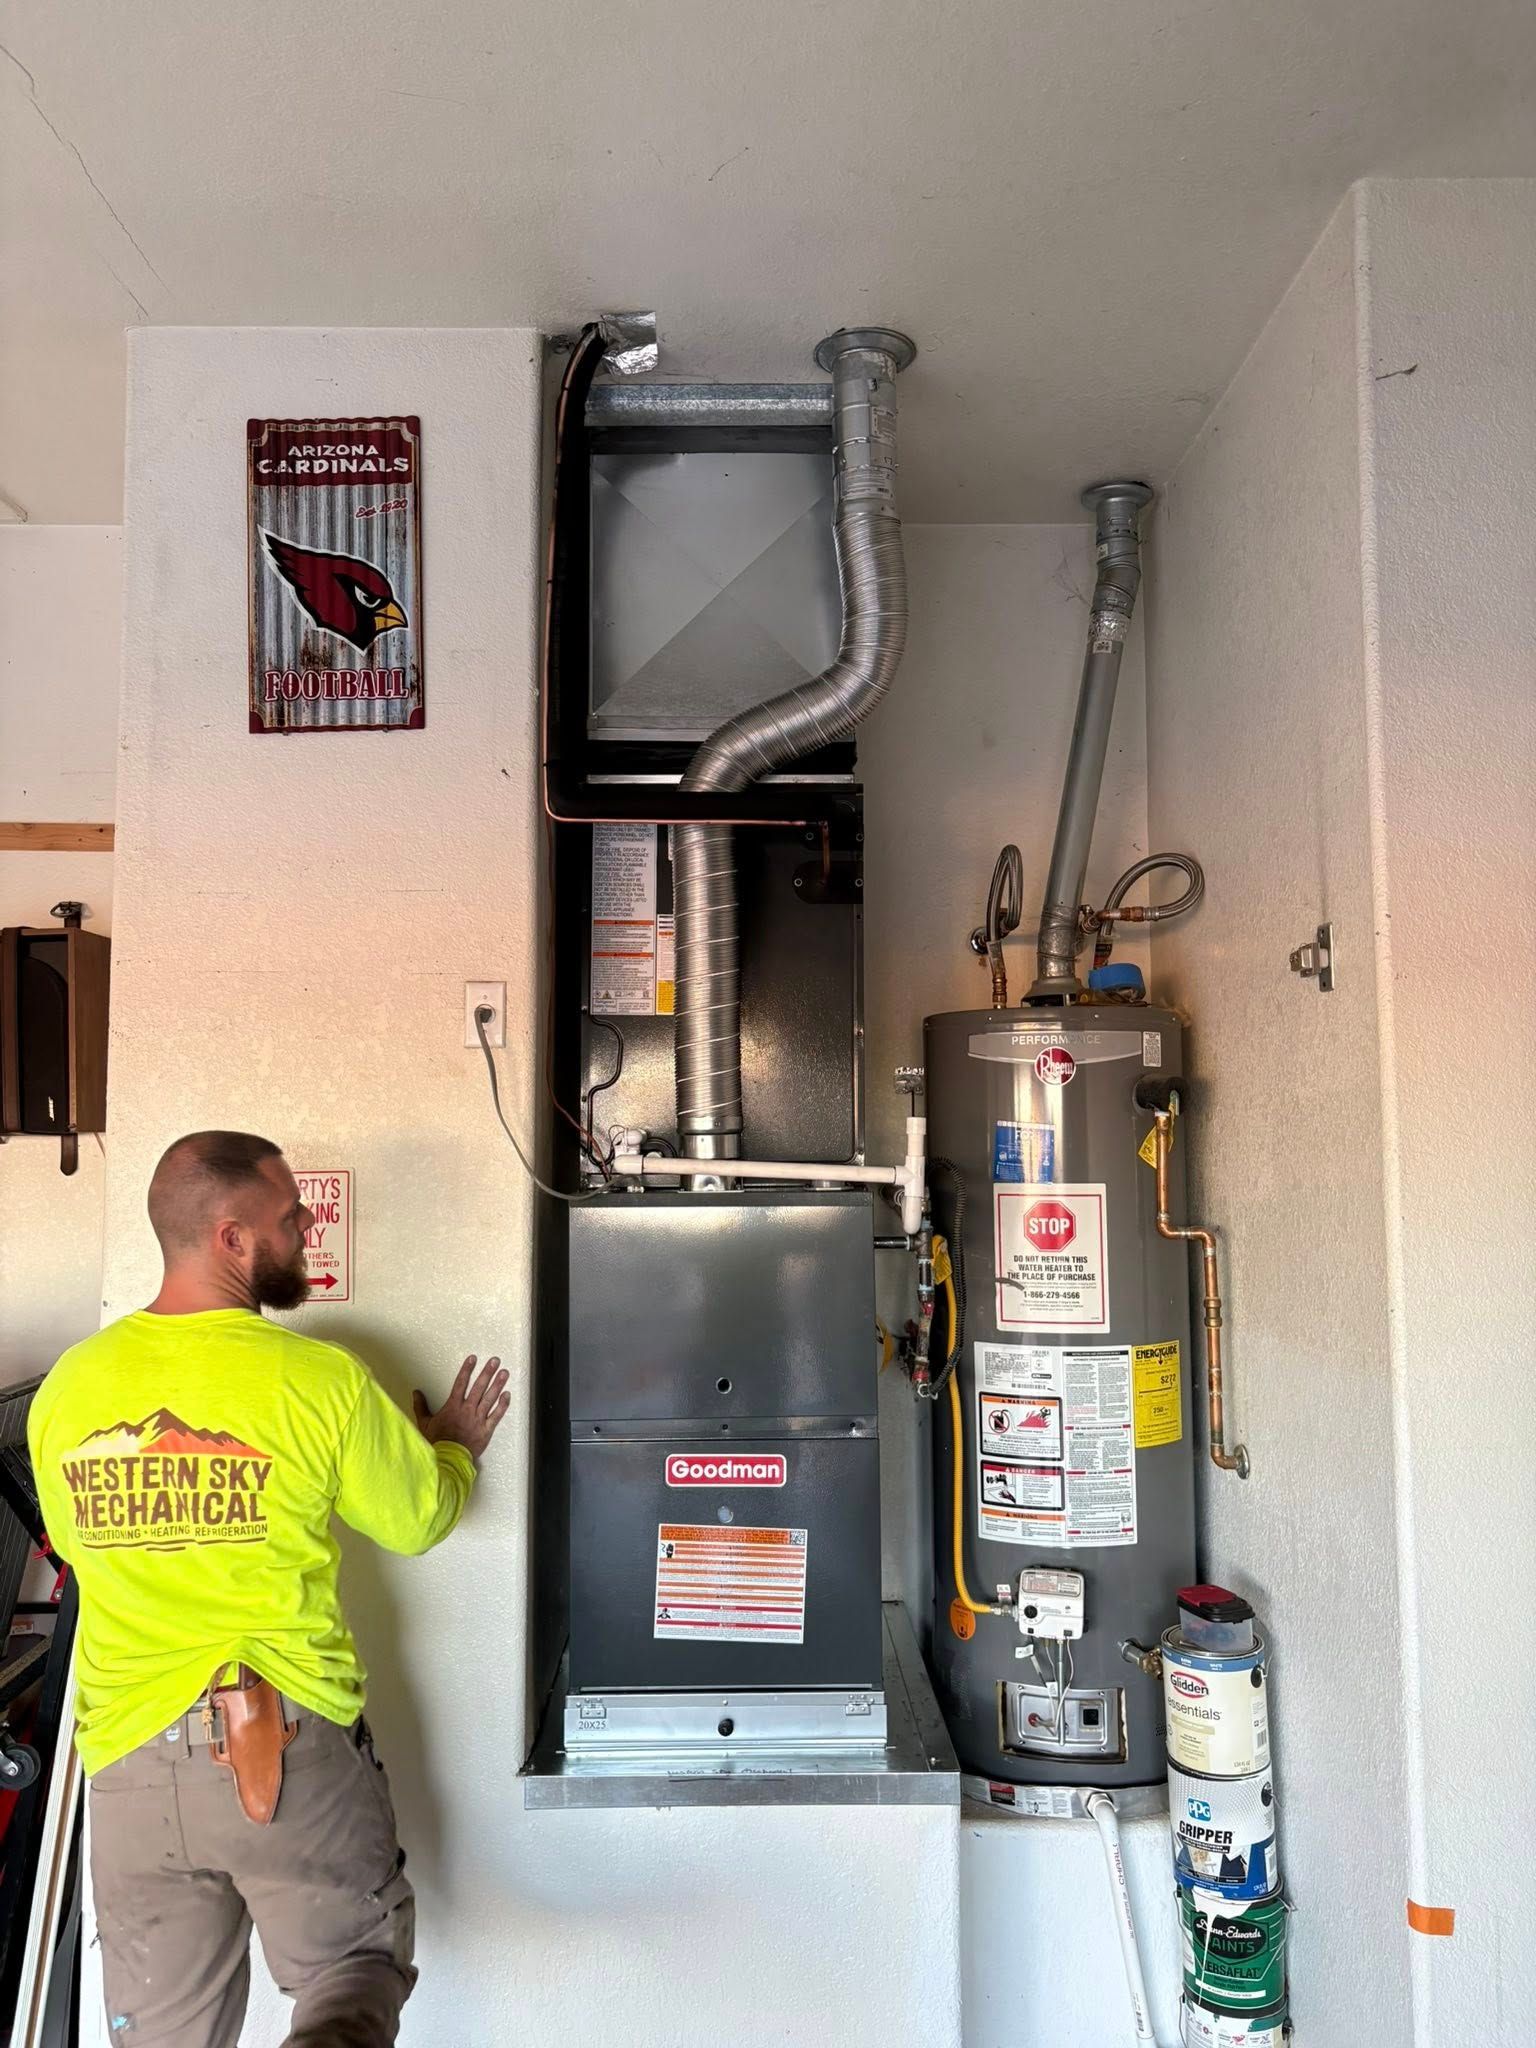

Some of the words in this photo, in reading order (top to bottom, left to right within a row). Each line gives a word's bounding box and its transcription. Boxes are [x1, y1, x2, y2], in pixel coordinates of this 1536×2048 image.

[288, 444, 379, 457] ARIZONA
[257, 457, 409, 474] CARDINALS
[265, 668, 409, 701] FOOTBALL
[1011, 1035, 1101, 1046] PERFORMCE
[1040, 1049, 1073, 1078] Rheem
[1029, 1217, 1070, 1235] STOP
[312, 1260, 341, 1268] TOWED
[1013, 1255, 1024, 1263] DO
[1025, 1255, 1039, 1263] NOT
[1041, 1255, 1070, 1263] RETURN
[1018, 1264, 1043, 1272] WATER
[1044, 1264, 1072, 1272] HEATER
[1007, 1272, 1020, 1280] THE
[1022, 1272, 1044, 1280] PLACE
[1058, 1273, 1096, 1281] PURCHASE
[1023, 1291, 1080, 1299] 1-866-279-4566
[62, 1456, 200, 1492] WESTERN
[208, 1457, 273, 1492] SKY
[671, 1459, 780, 1479] Goodman
[73, 1490, 267, 1529] MECHANICAL
[150, 1525, 190, 1537] HEATING
[195, 1523, 268, 1537] REFRIGERATION
[1170, 1673, 1209, 1695] Glidden
[1167, 1697, 1222, 1720] essentials
[578, 1720, 606, 1730] 20X25
[1188, 1800, 1211, 1818] PPG
[1179, 1820, 1234, 1845] GRIPPER
[1196, 1919, 1262, 1939] Dnn-Edwards
